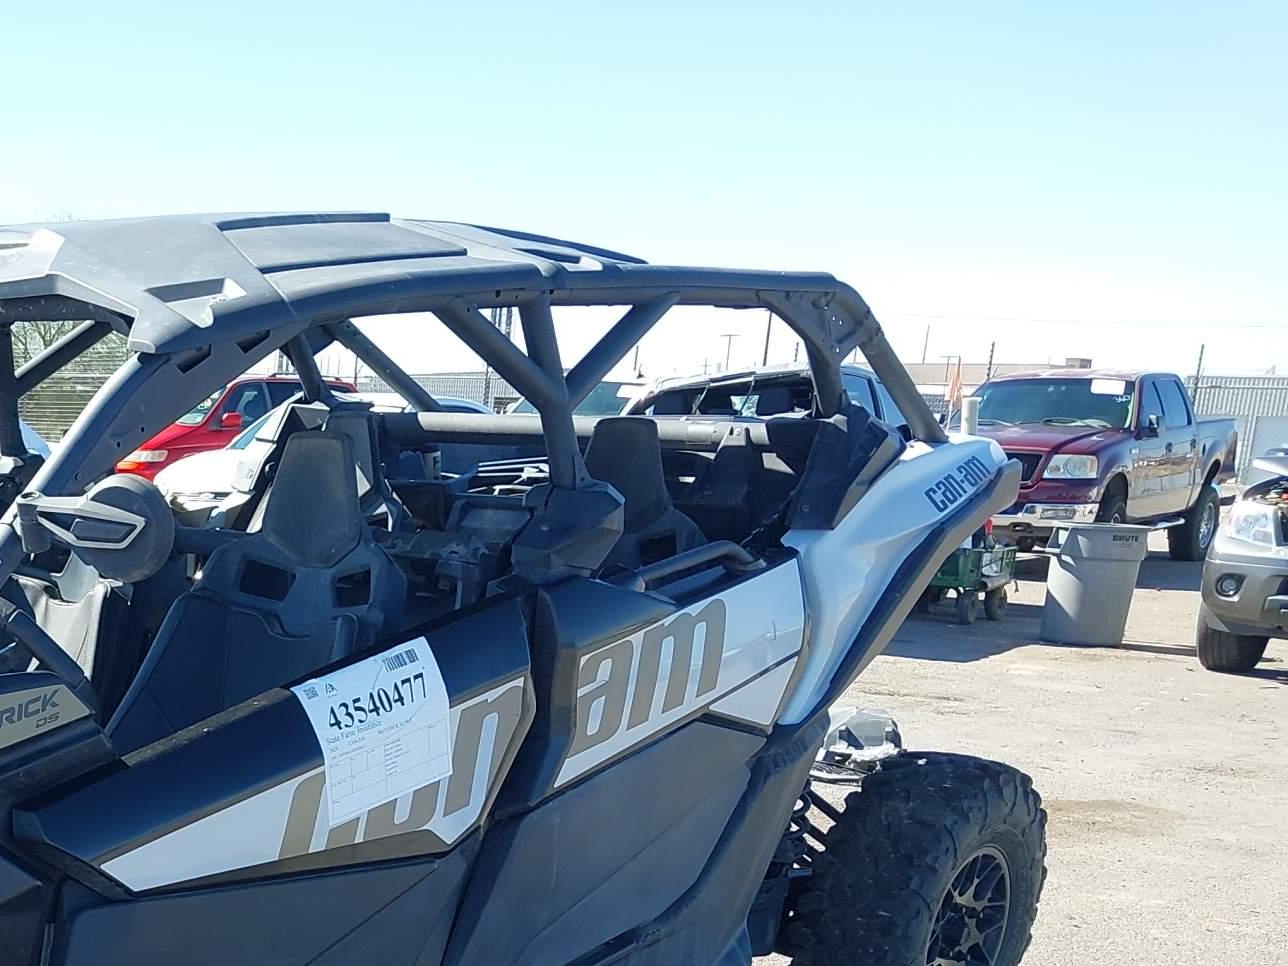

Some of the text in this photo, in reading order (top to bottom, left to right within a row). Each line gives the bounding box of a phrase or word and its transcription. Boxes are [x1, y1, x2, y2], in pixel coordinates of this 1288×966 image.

[924, 455, 991, 513] can-am
[328, 671, 427, 731] 43540477
[566, 598, 727, 758] am
[35, 711, 60, 729] DS
